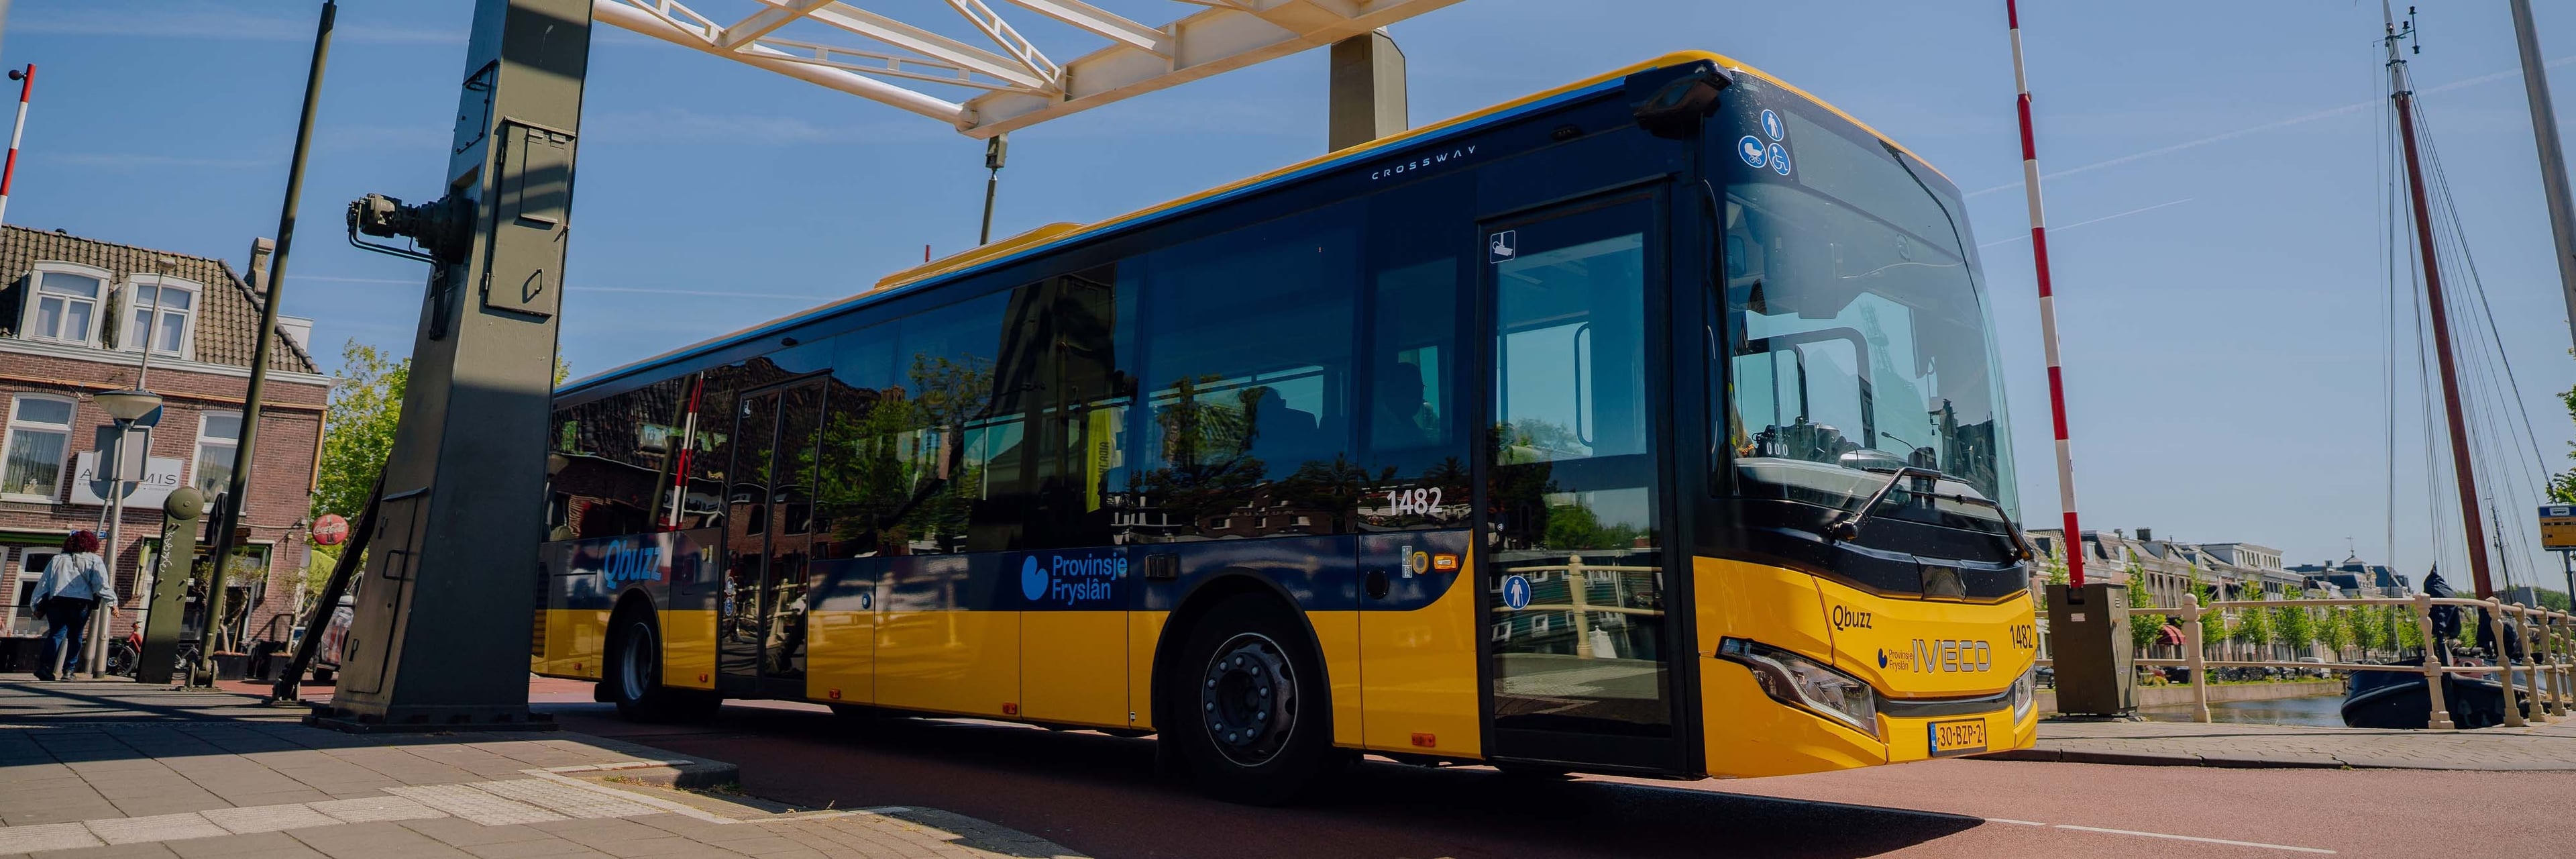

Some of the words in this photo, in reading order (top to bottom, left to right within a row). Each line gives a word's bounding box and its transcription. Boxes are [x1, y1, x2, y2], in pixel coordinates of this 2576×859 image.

[1372, 145, 1475, 180] CROSSWAY
[1387, 487, 1443, 515] 1482
[604, 540, 663, 589] Qbuzz
[1053, 552, 1128, 580] Provinsje
[1053, 578, 1111, 605] Fryslân
[1833, 605, 1872, 631] Qbuzz
[2010, 624, 2033, 649] 1482
[1888, 649, 1913, 662] Provinsje
[1912, 639, 1991, 673] IVECO
[1939, 724, 1982, 746] 30-BZP-2
